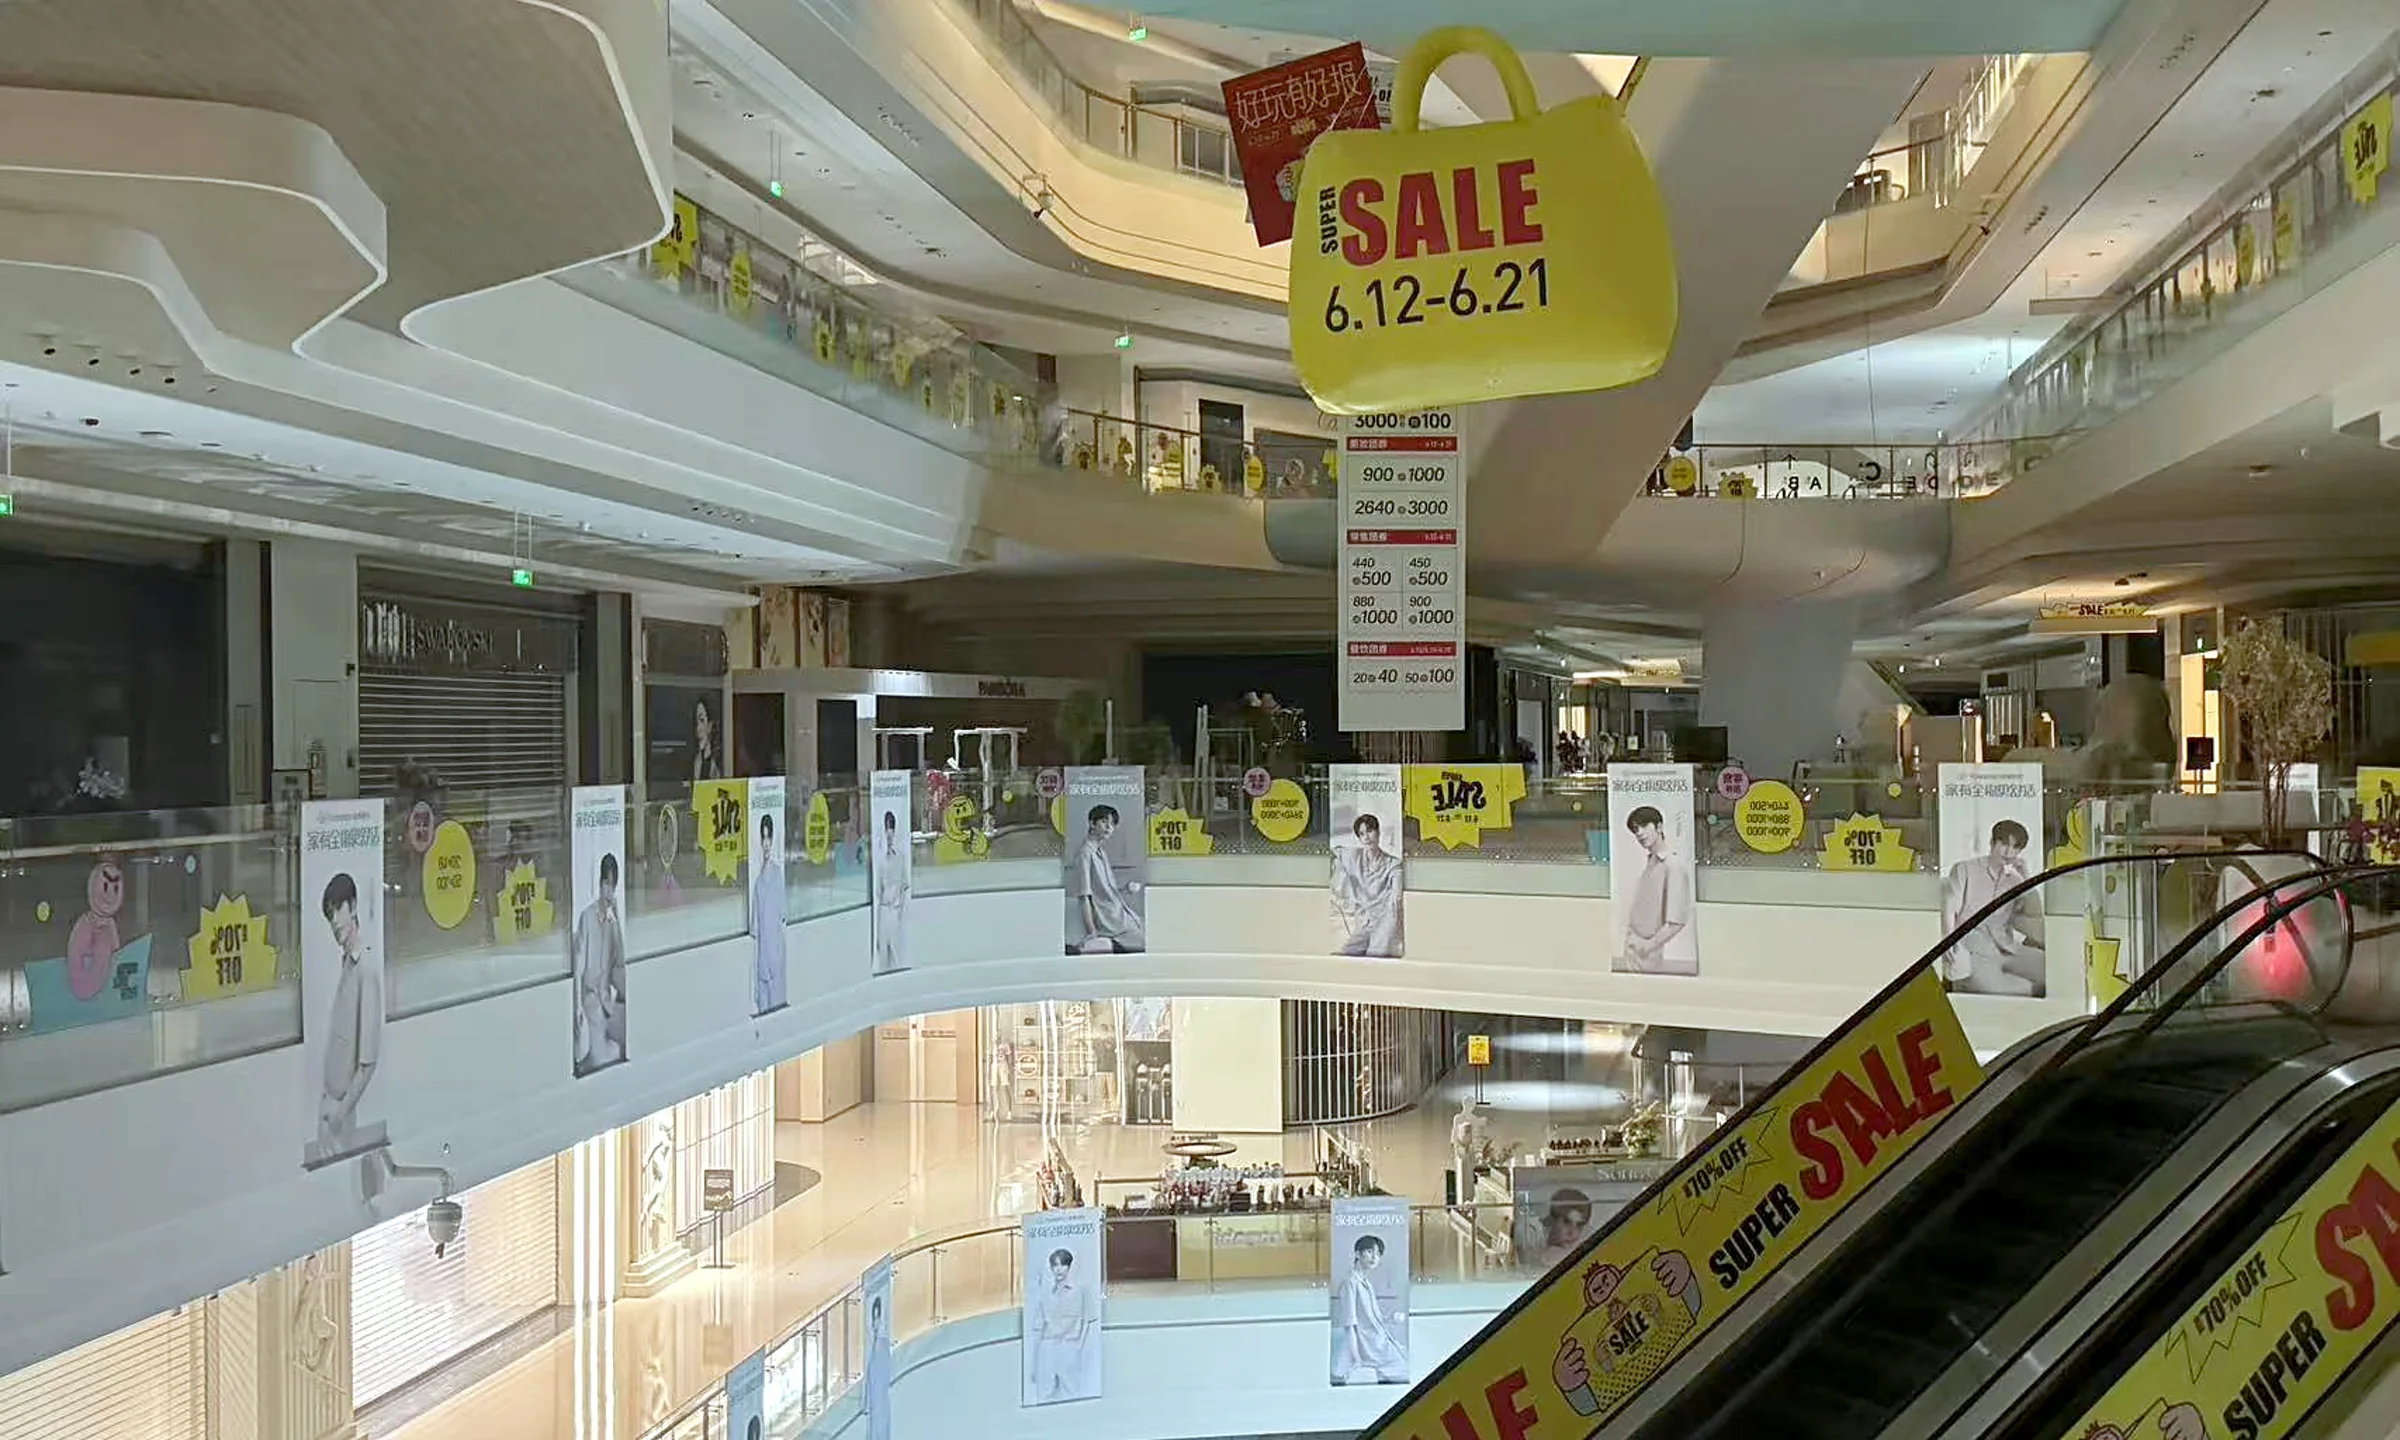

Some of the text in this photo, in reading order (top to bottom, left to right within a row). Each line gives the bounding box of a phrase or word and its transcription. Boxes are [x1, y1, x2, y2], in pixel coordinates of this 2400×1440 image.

[1235, 61, 1363, 134] 好玩有好报
[1319, 184, 1339, 255] SUPER
[1339, 157, 1545, 267] SALE
[1324, 257, 1550, 333] 6.12-6.21
[1421, 412, 1451, 429] 100
[1362, 467, 1445, 482] 900 1000
[1354, 499, 1448, 515] 2640 3000
[1352, 557, 1376, 568] 440
[1409, 557, 1431, 568] 450
[1361, 570, 1392, 586] 500
[1418, 570, 1448, 586] 500
[1352, 595, 1375, 607] 880
[1409, 595, 1432, 607] 900
[1361, 609, 1398, 624] 1000
[1418, 609, 1454, 624] 1000
[1377, 668, 1398, 684] 40
[1429, 668, 1454, 684] 100
[1790, 1018, 1956, 1201] SALE
[1708, 1182, 1802, 1290] SUPER
[2314, 1137, 2400, 1332] SA
[1609, 1310, 1650, 1356] SALE
[2222, 1309, 2329, 1440] SUPER
